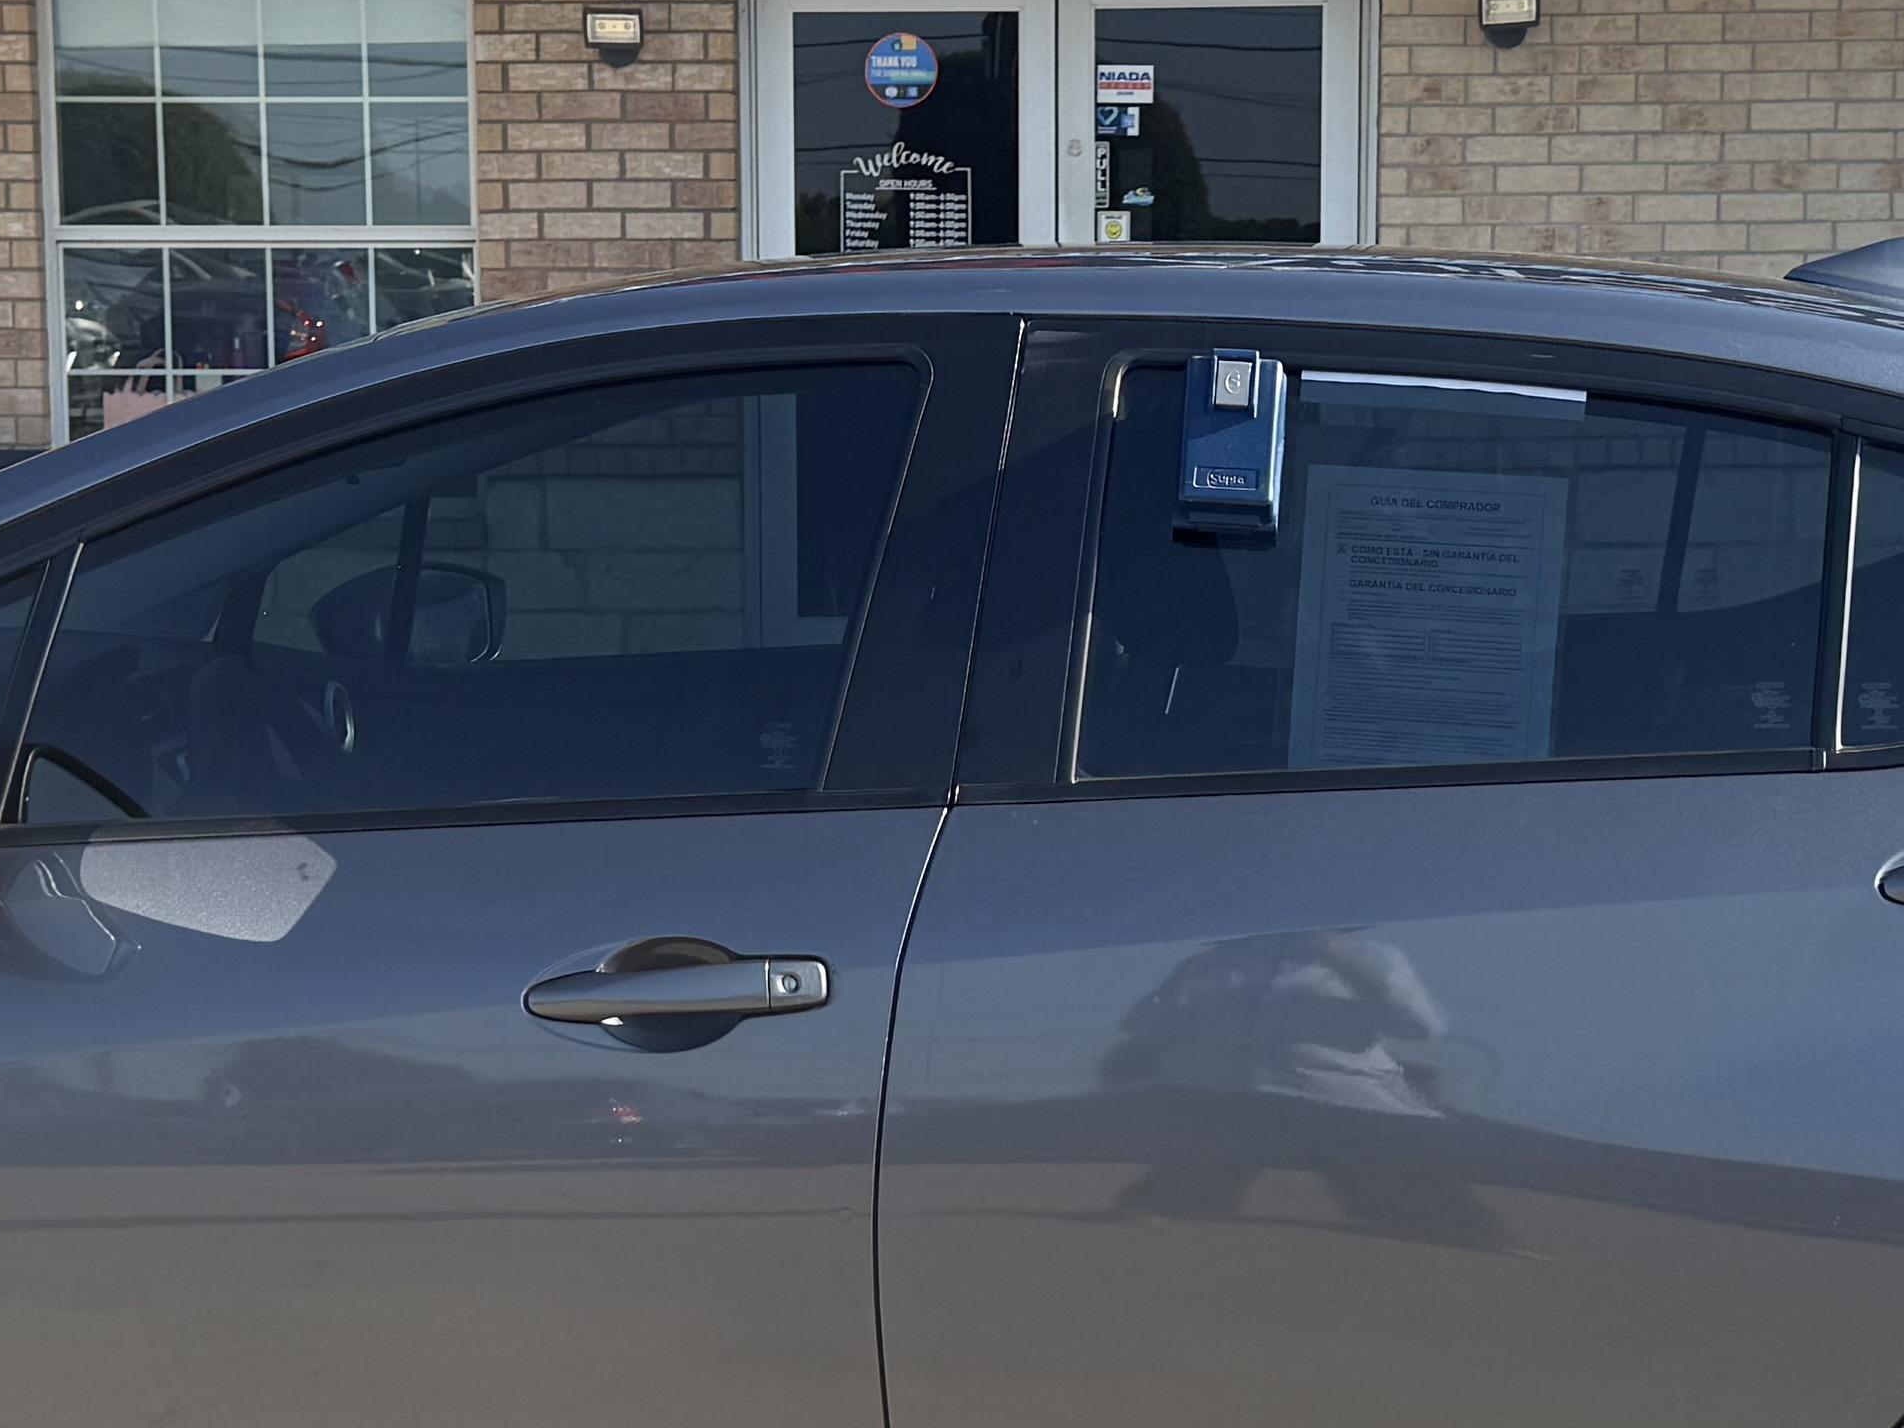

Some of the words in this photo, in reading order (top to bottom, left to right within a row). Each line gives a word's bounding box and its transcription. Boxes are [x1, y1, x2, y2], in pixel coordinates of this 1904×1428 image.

[871, 56, 899, 67] THANK
[900, 56, 918, 67] YOU
[1099, 71, 1152, 81] NIADA
[853, 141, 956, 177] Welcome
[1097, 147, 1106, 192] PULL
[879, 179, 902, 188] OPEN
[903, 179, 933, 188] HOURS
[1209, 472, 1245, 486] Supra
[1401, 498, 1423, 508] DEL
[1426, 499, 1501, 512] COMPRADOR
[1422, 549, 1440, 559] SIN
[1498, 553, 1520, 563] DEL
[1405, 581, 1425, 592] DEL
